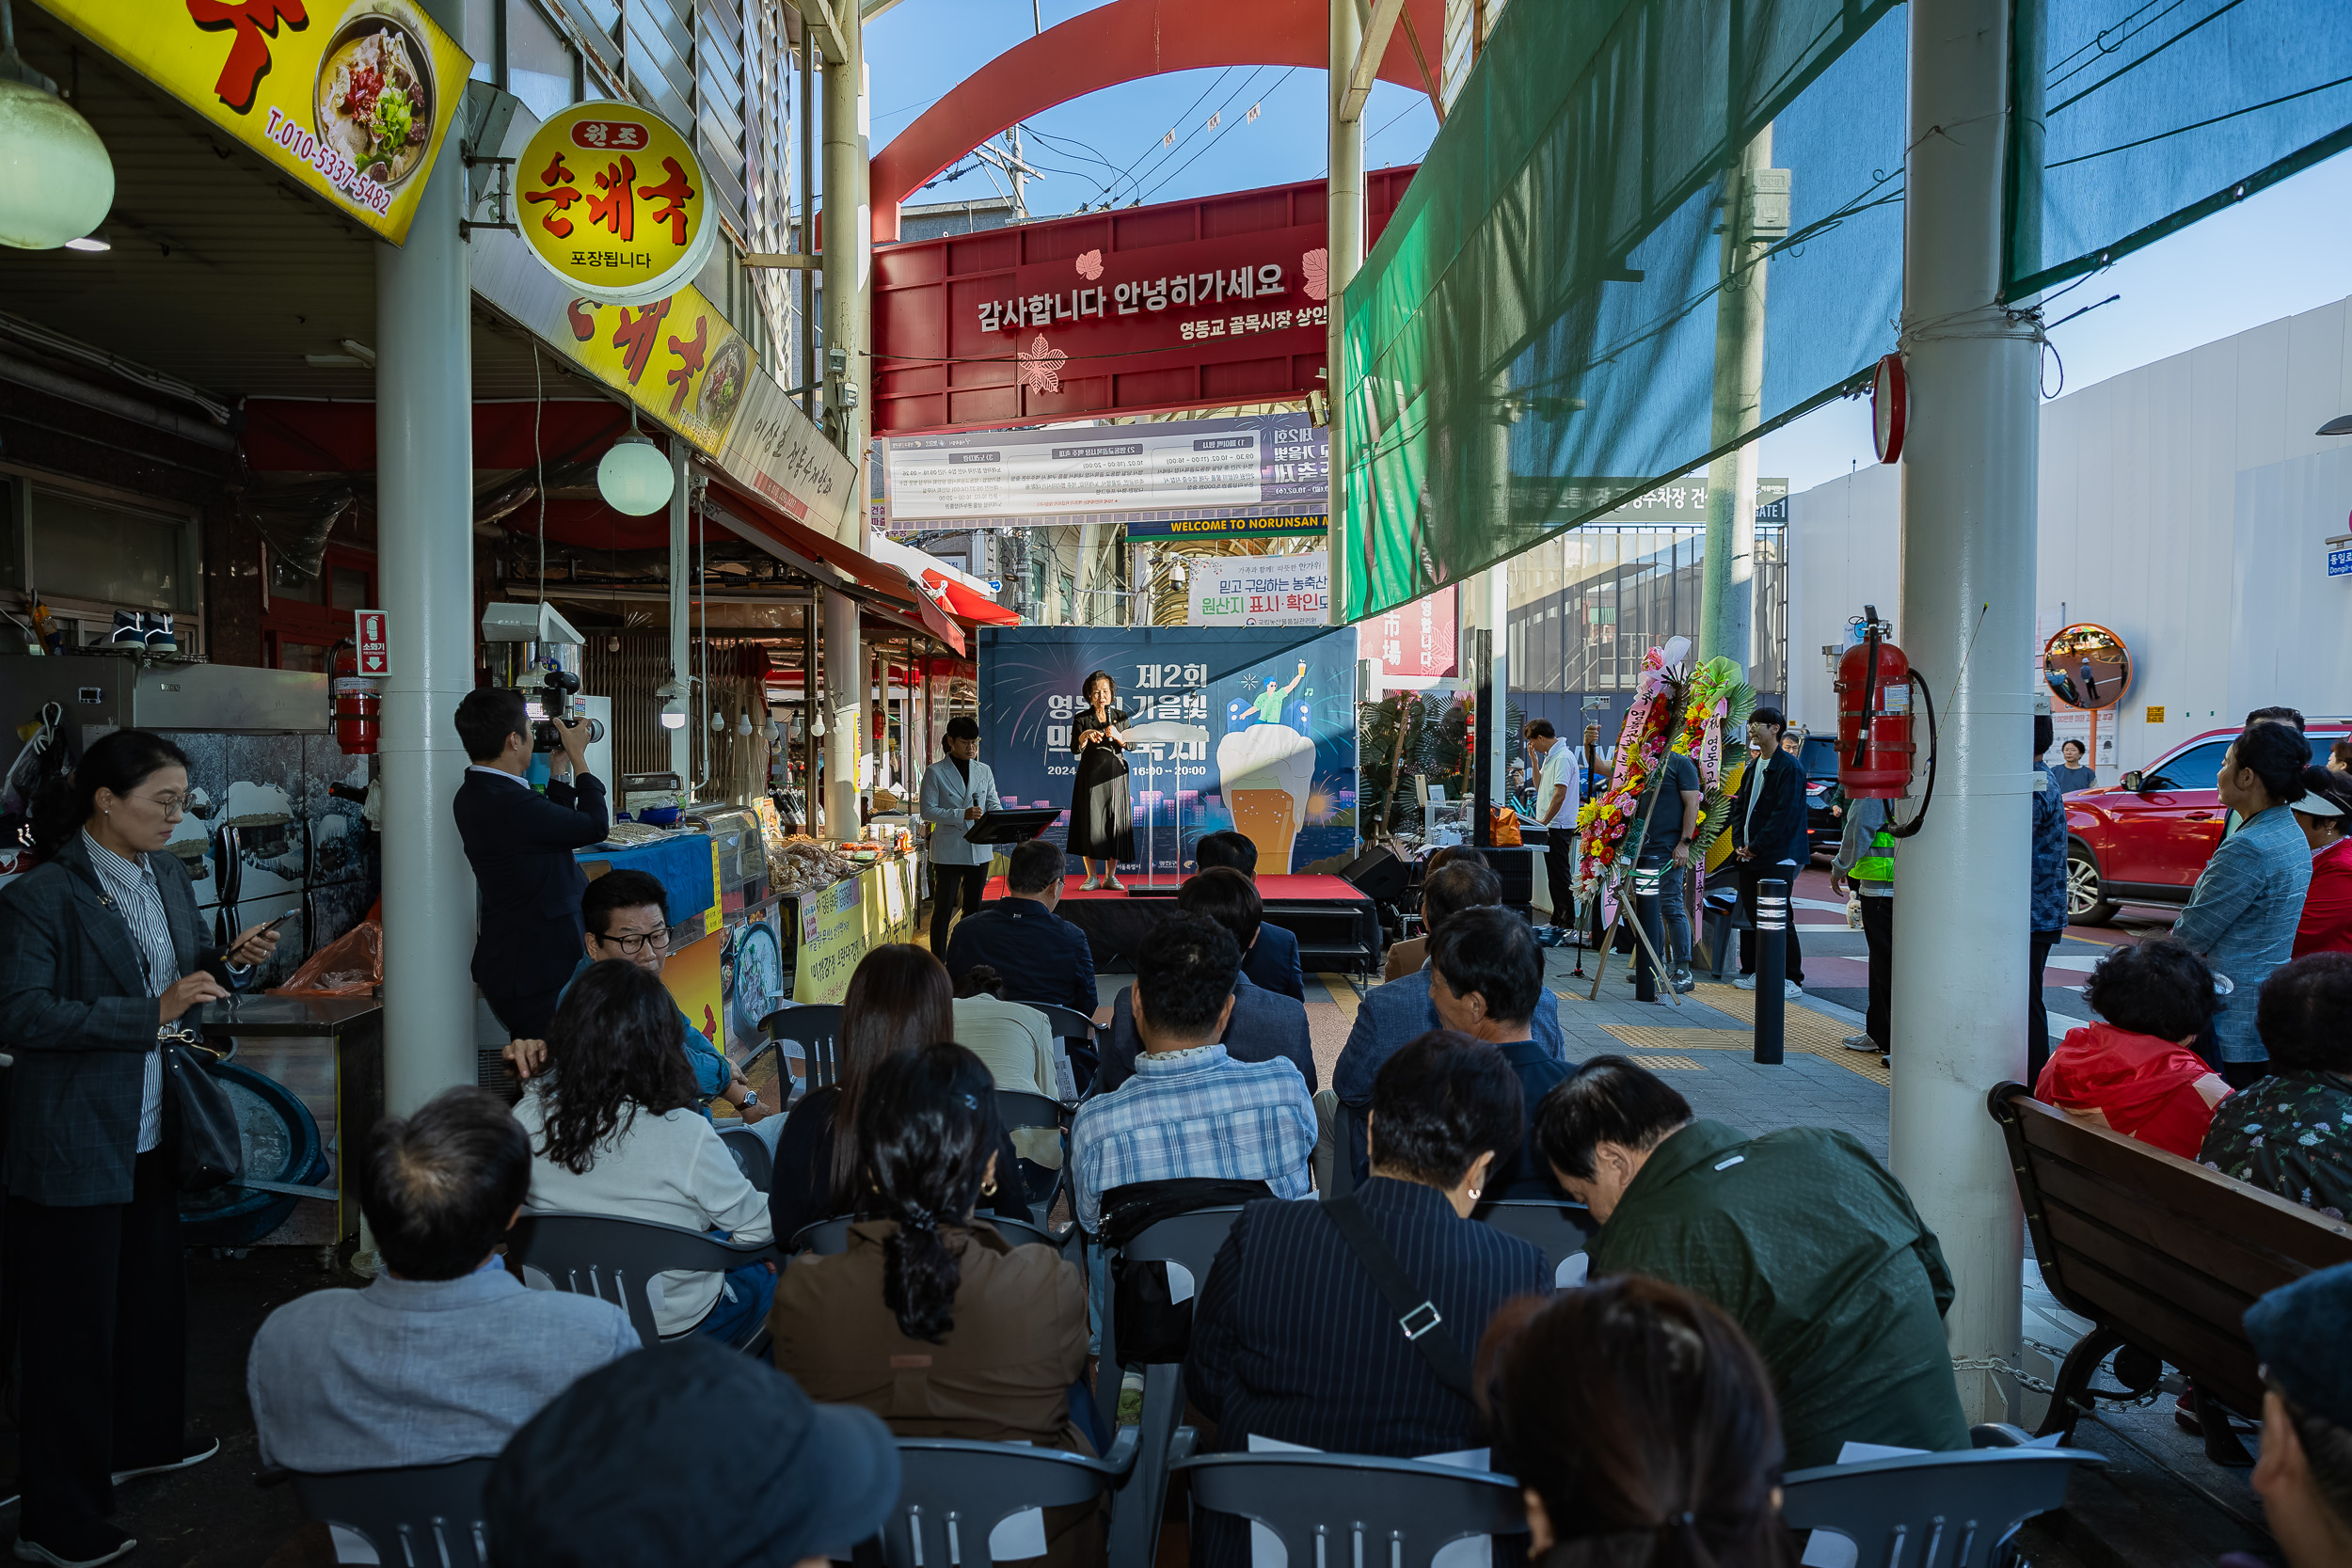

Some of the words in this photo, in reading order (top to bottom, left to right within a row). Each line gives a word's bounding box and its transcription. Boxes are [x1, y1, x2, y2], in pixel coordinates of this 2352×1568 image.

[584, 123, 639, 147] 원조
[265, 108, 392, 216] T.010-5337-5482
[524, 150, 695, 246] 순대국
[570, 251, 651, 268] 포장됩니다
[977, 286, 1106, 333] 감사합니다
[1114, 263, 1285, 316] 안녕히가세요
[1180, 319, 1226, 341] 영동교
[1229, 309, 1293, 335] 골목시장
[567, 295, 707, 416] 대국
[1690, 486, 1708, 509] 건
[1779, 499, 1786, 517] 1
[1170, 519, 1227, 531] WELCOME
[1230, 519, 1246, 530] TO
[1248, 516, 1318, 529] NORUNSAN
[1238, 565, 1258, 574] 가족과
[1259, 564, 1274, 574] 함께!
[1277, 563, 1296, 573] 따뜻한
[1219, 579, 1242, 594] 믿고
[1245, 578, 1289, 594] 구입하는
[1201, 596, 1245, 615] 원산지
[362, 642, 386, 651] 소화기
[1135, 663, 1208, 689] 제2회
[1131, 694, 1208, 720] 가을빛
[1132, 767, 1163, 776] 16:00
[1175, 766, 1206, 775] 20:00
